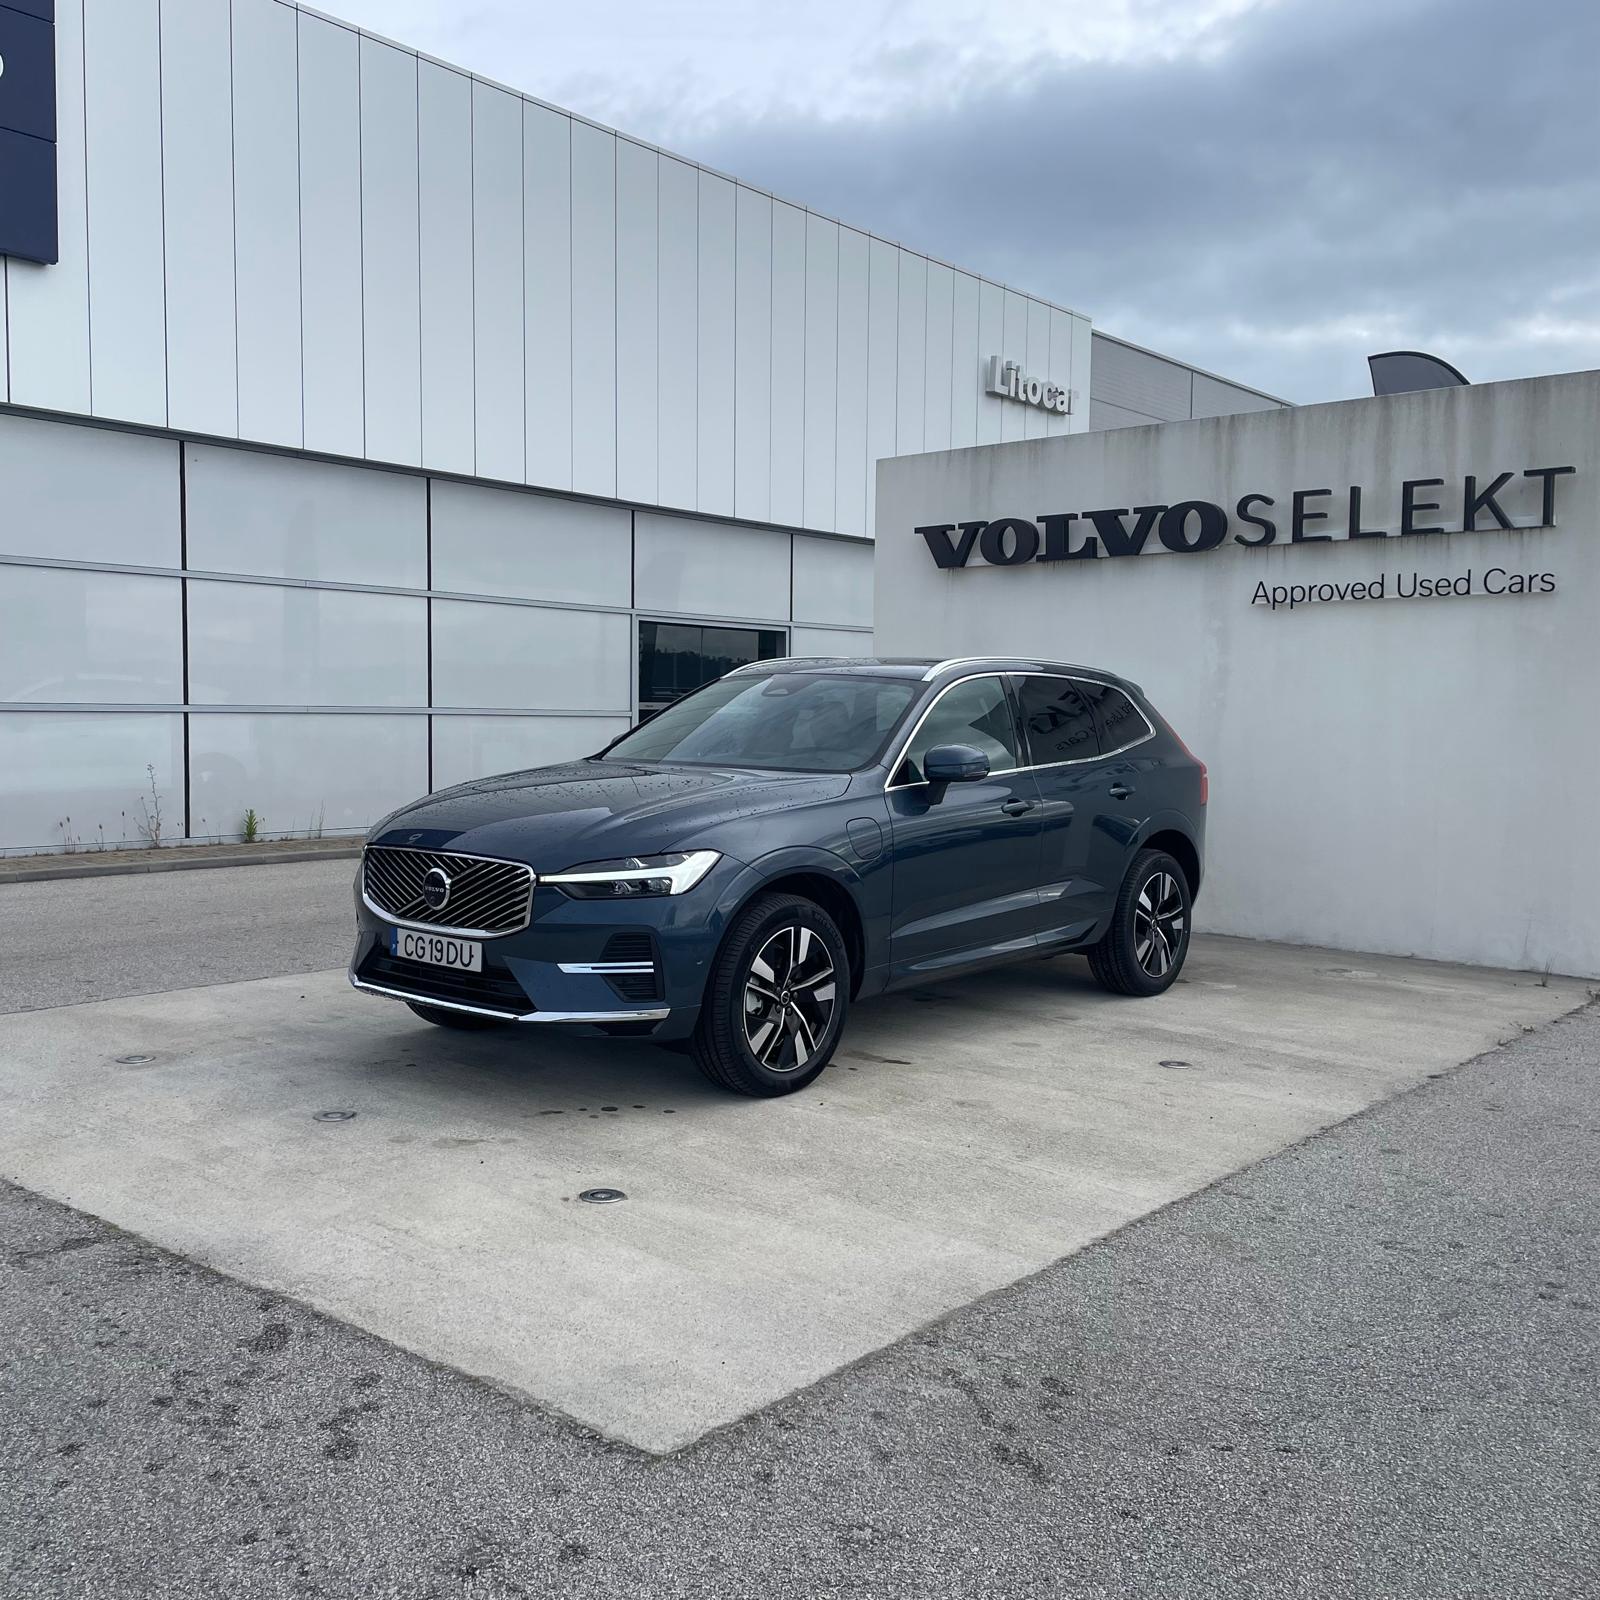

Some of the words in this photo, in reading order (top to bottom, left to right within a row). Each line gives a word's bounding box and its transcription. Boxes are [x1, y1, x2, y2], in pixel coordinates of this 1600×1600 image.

[984, 355, 1079, 415] Litocar
[1251, 573, 1385, 610] Approved
[1397, 568, 1472, 598] Used
[1483, 567, 1556, 595] Cars
